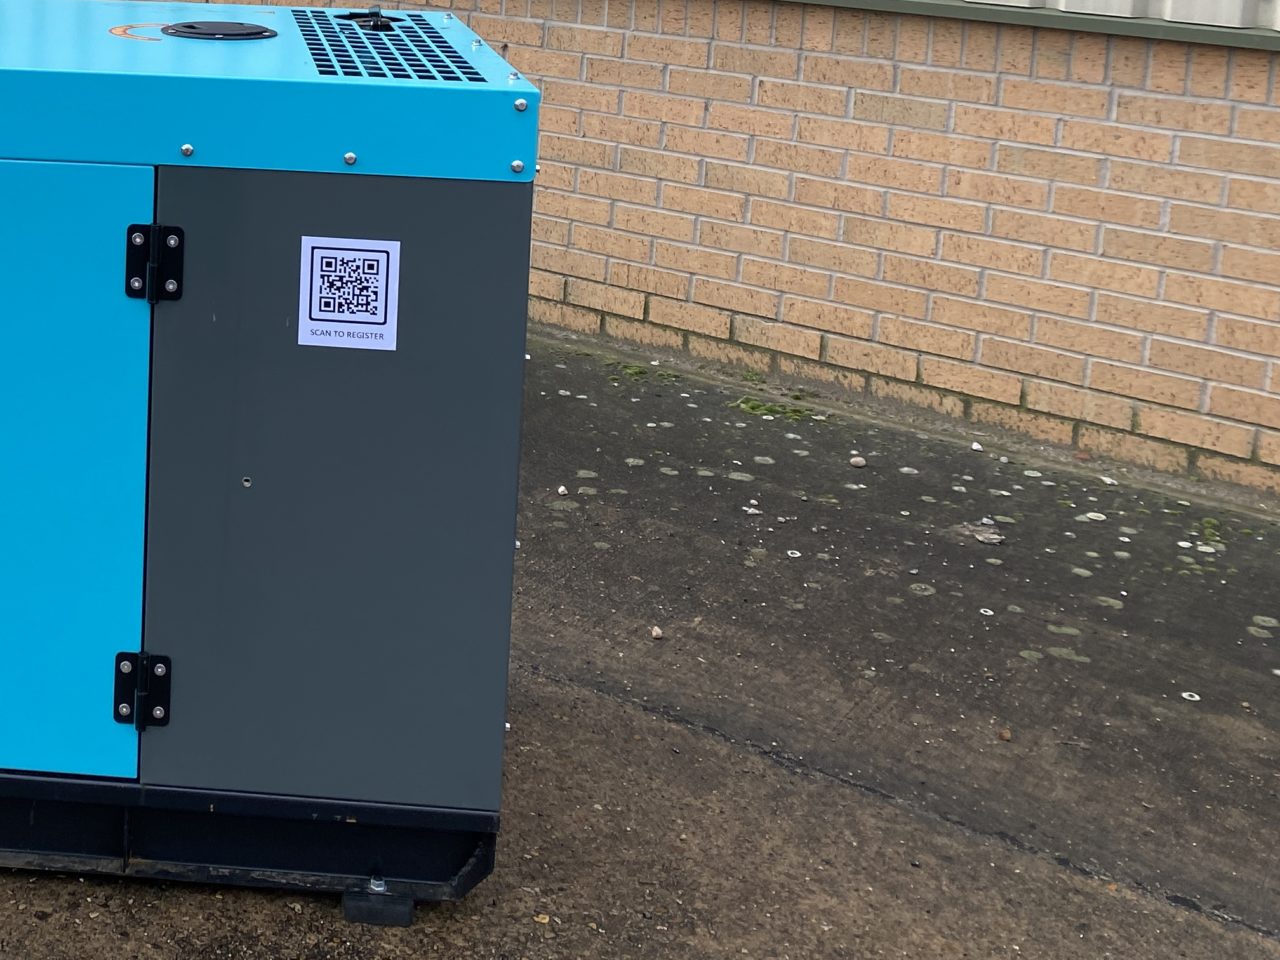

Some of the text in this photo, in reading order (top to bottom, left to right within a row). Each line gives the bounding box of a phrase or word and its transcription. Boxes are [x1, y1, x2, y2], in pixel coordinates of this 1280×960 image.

[310, 329, 384, 340] SCAN TO REGISTER
